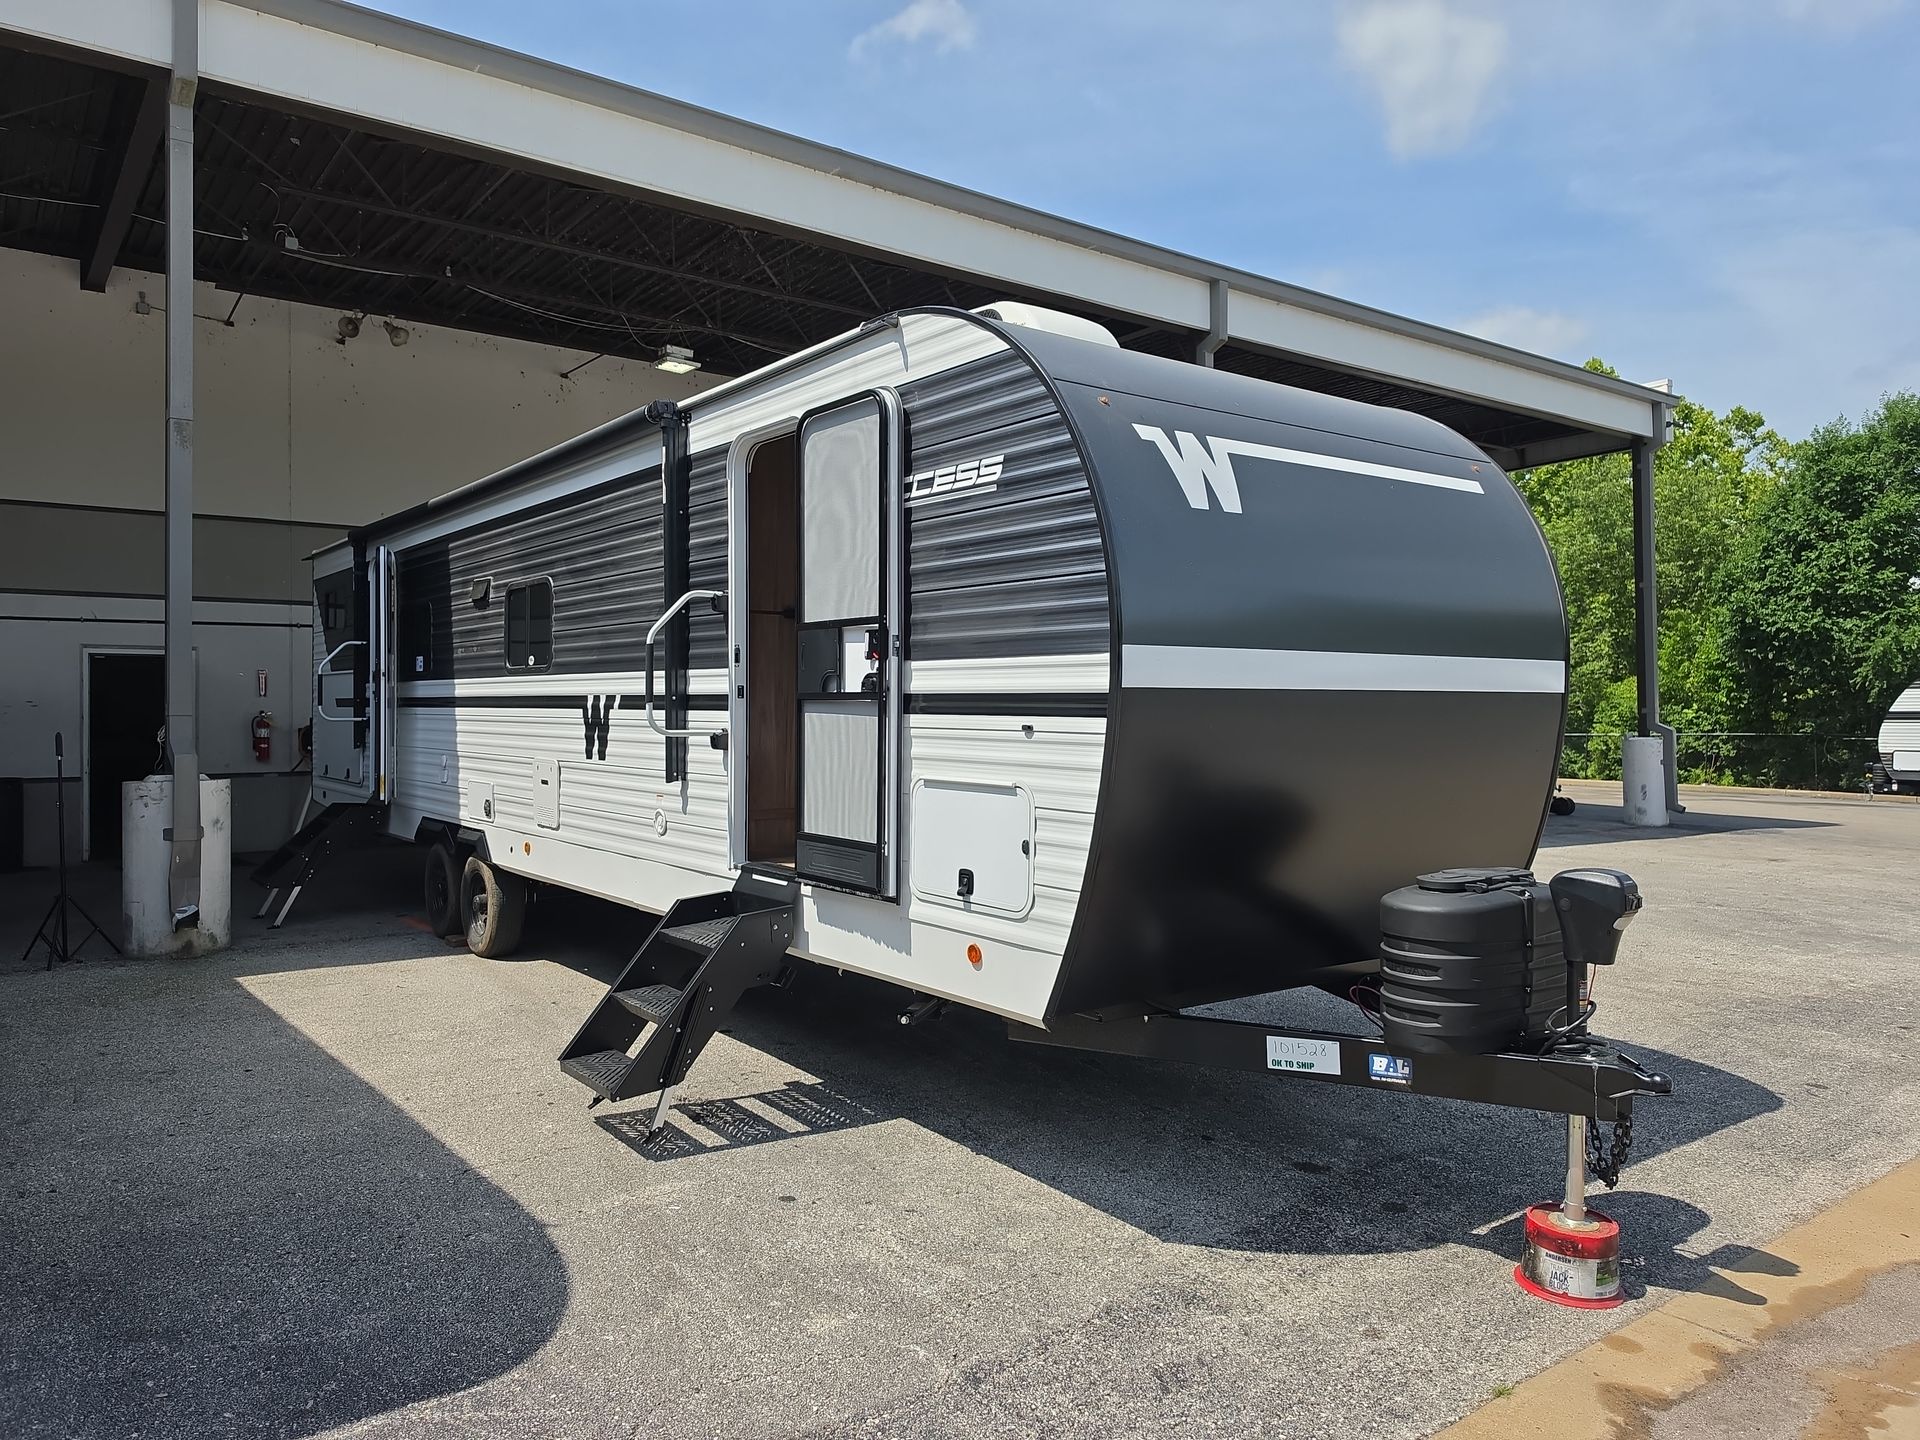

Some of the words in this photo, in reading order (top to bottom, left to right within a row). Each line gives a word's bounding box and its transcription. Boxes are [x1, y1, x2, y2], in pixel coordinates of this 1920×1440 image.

[1131, 423, 1243, 514] W
[1273, 1039, 1327, 1057] 101528
[1271, 1058, 1283, 1068] OK
[1284, 1059, 1294, 1068] TO
[1296, 1061, 1315, 1070] SHIP
[1372, 1056, 1410, 1074] BAL
[1545, 1252, 1572, 1264] ANDERSEN
[1548, 1279, 1570, 1292] BLOCK
